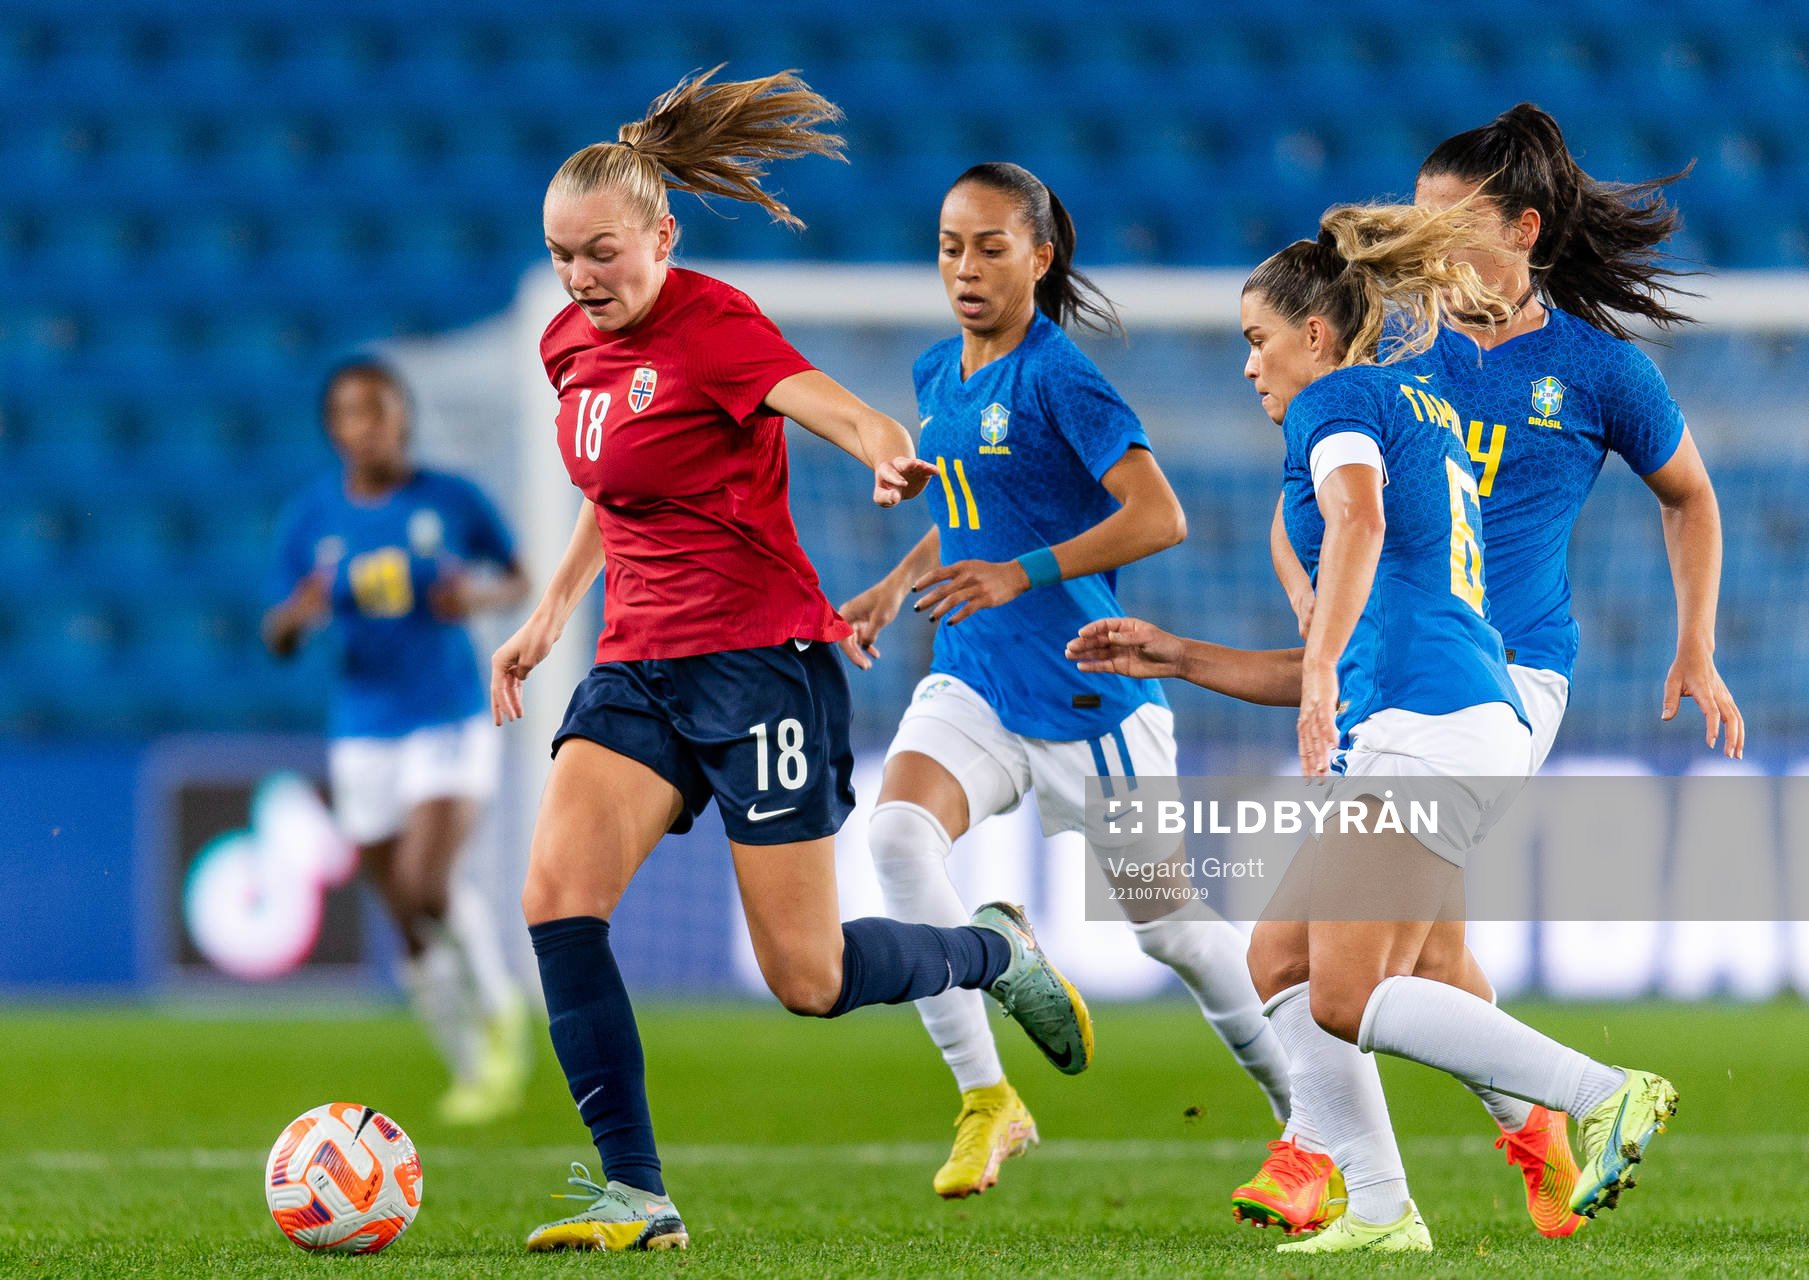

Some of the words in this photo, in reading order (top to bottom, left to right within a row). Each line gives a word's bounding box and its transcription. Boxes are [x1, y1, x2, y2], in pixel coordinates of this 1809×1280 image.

[575, 389, 612, 462] 18
[979, 445, 1012, 454] BRASIL
[1400, 384, 1466, 450] TAM
[1528, 416, 1562, 430] BRASIL
[936, 455, 980, 530] 11
[1466, 420, 1507, 497] 4
[1445, 455, 1486, 619] 6
[749, 718, 808, 791] 18
